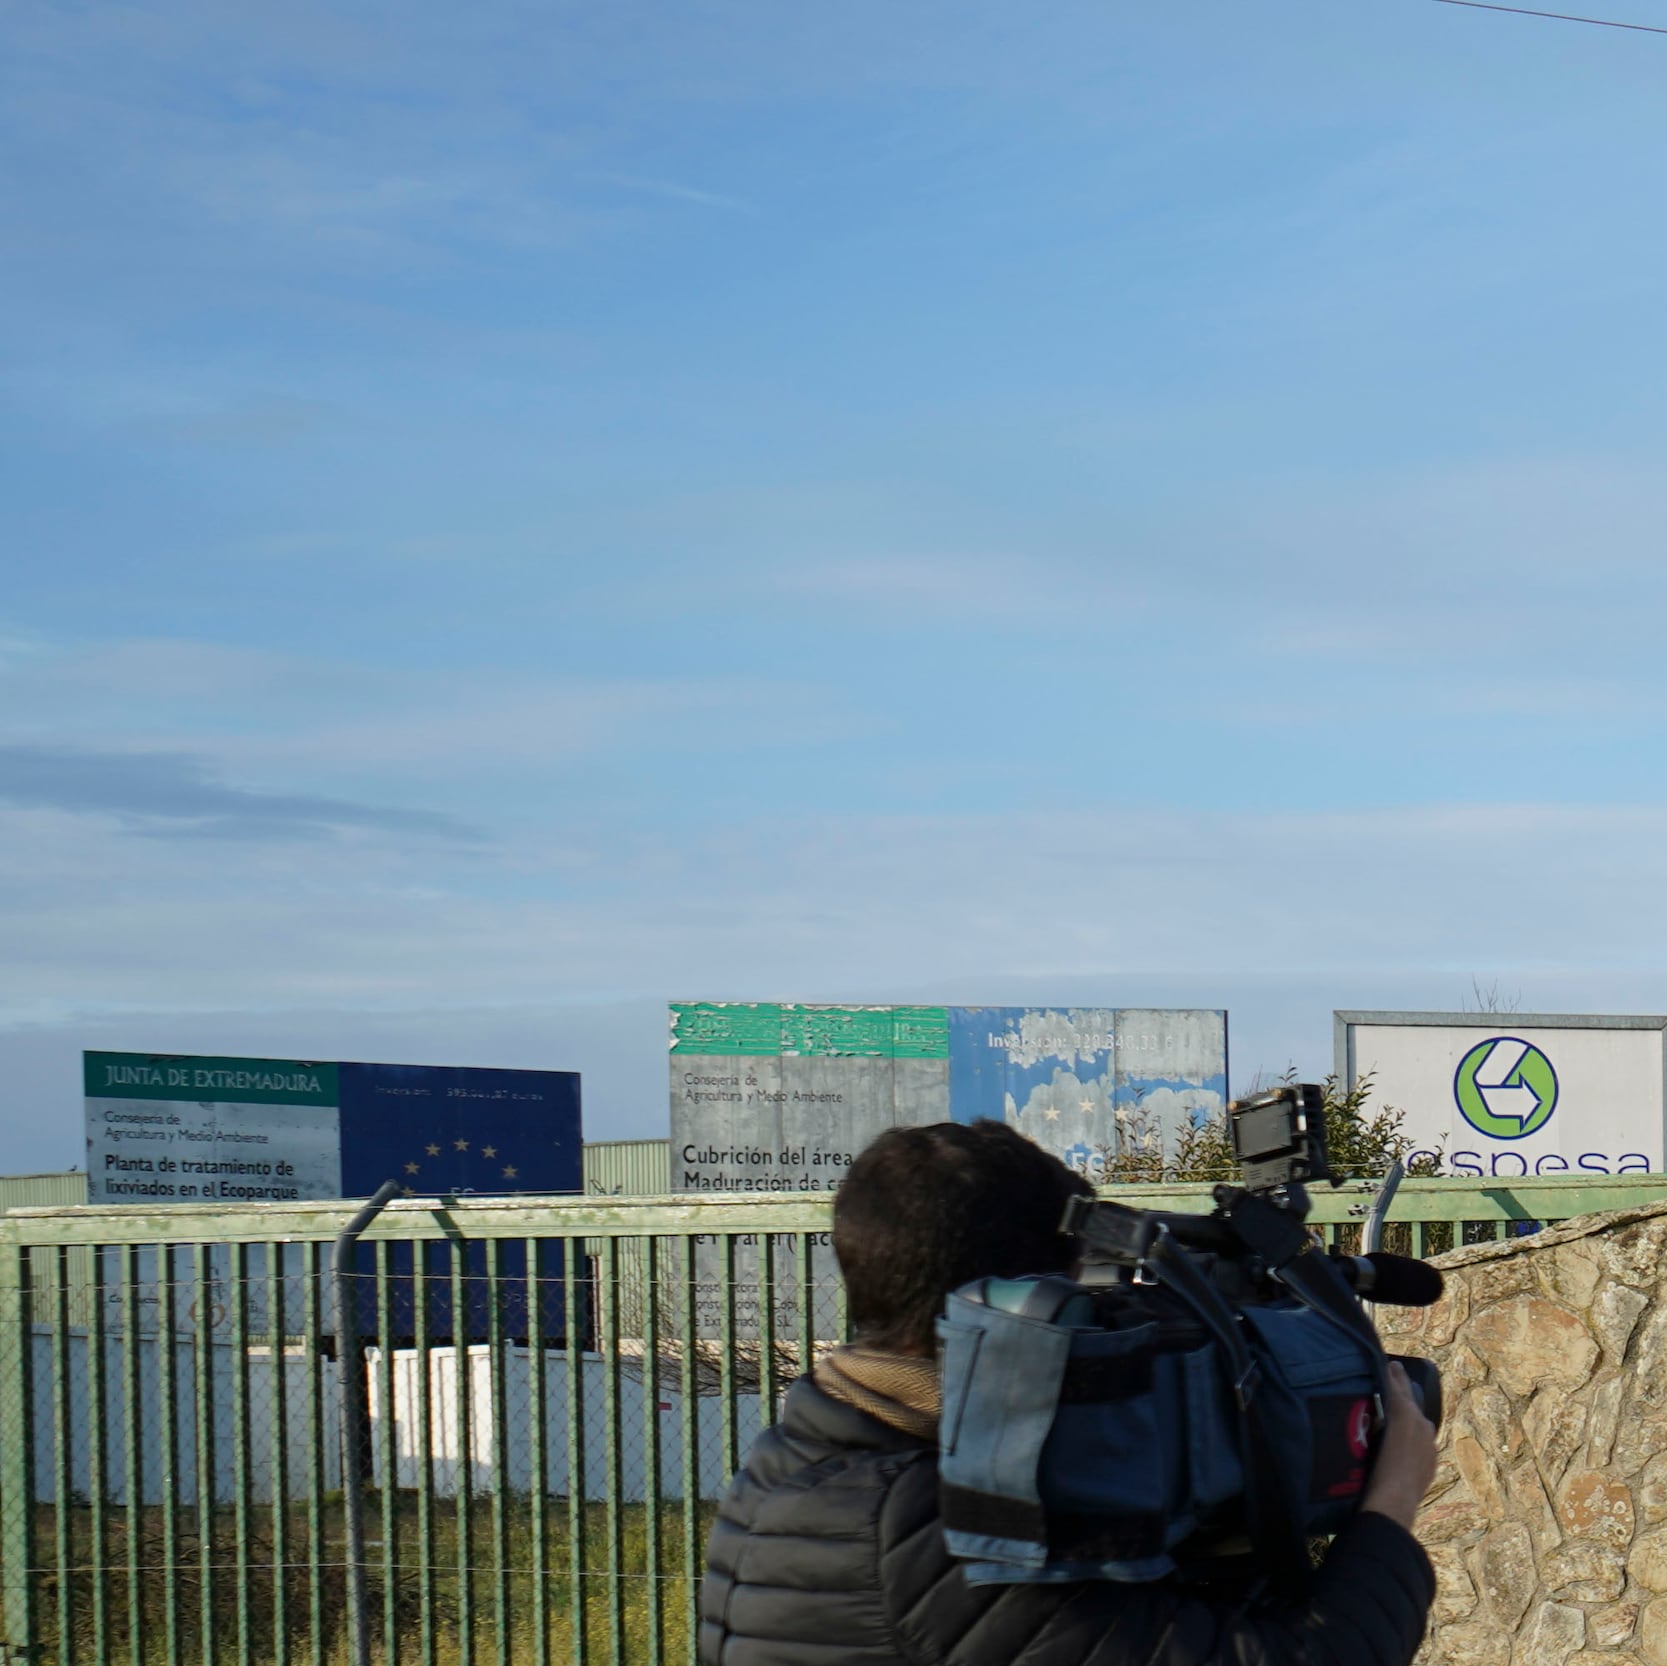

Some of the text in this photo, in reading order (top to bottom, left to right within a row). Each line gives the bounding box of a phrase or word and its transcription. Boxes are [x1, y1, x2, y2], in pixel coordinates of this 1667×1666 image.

[104, 1065, 322, 1093] JUNTA DE EXTREMADURA
[745, 1074, 758, 1086] de
[685, 1090, 844, 1104] Agricultura y Medio Ambiente
[166, 1113, 181, 1126] de
[104, 1127, 269, 1144] Agricultura y Medio Ambiente
[683, 1144, 853, 1166] Cubrición del área
[105, 1154, 294, 1177] Planta de tratamiento de
[105, 1177, 299, 1202] lixiviados en el Ecoparque
[685, 1171, 792, 1191] Maduración
[799, 1173, 820, 1191] de
